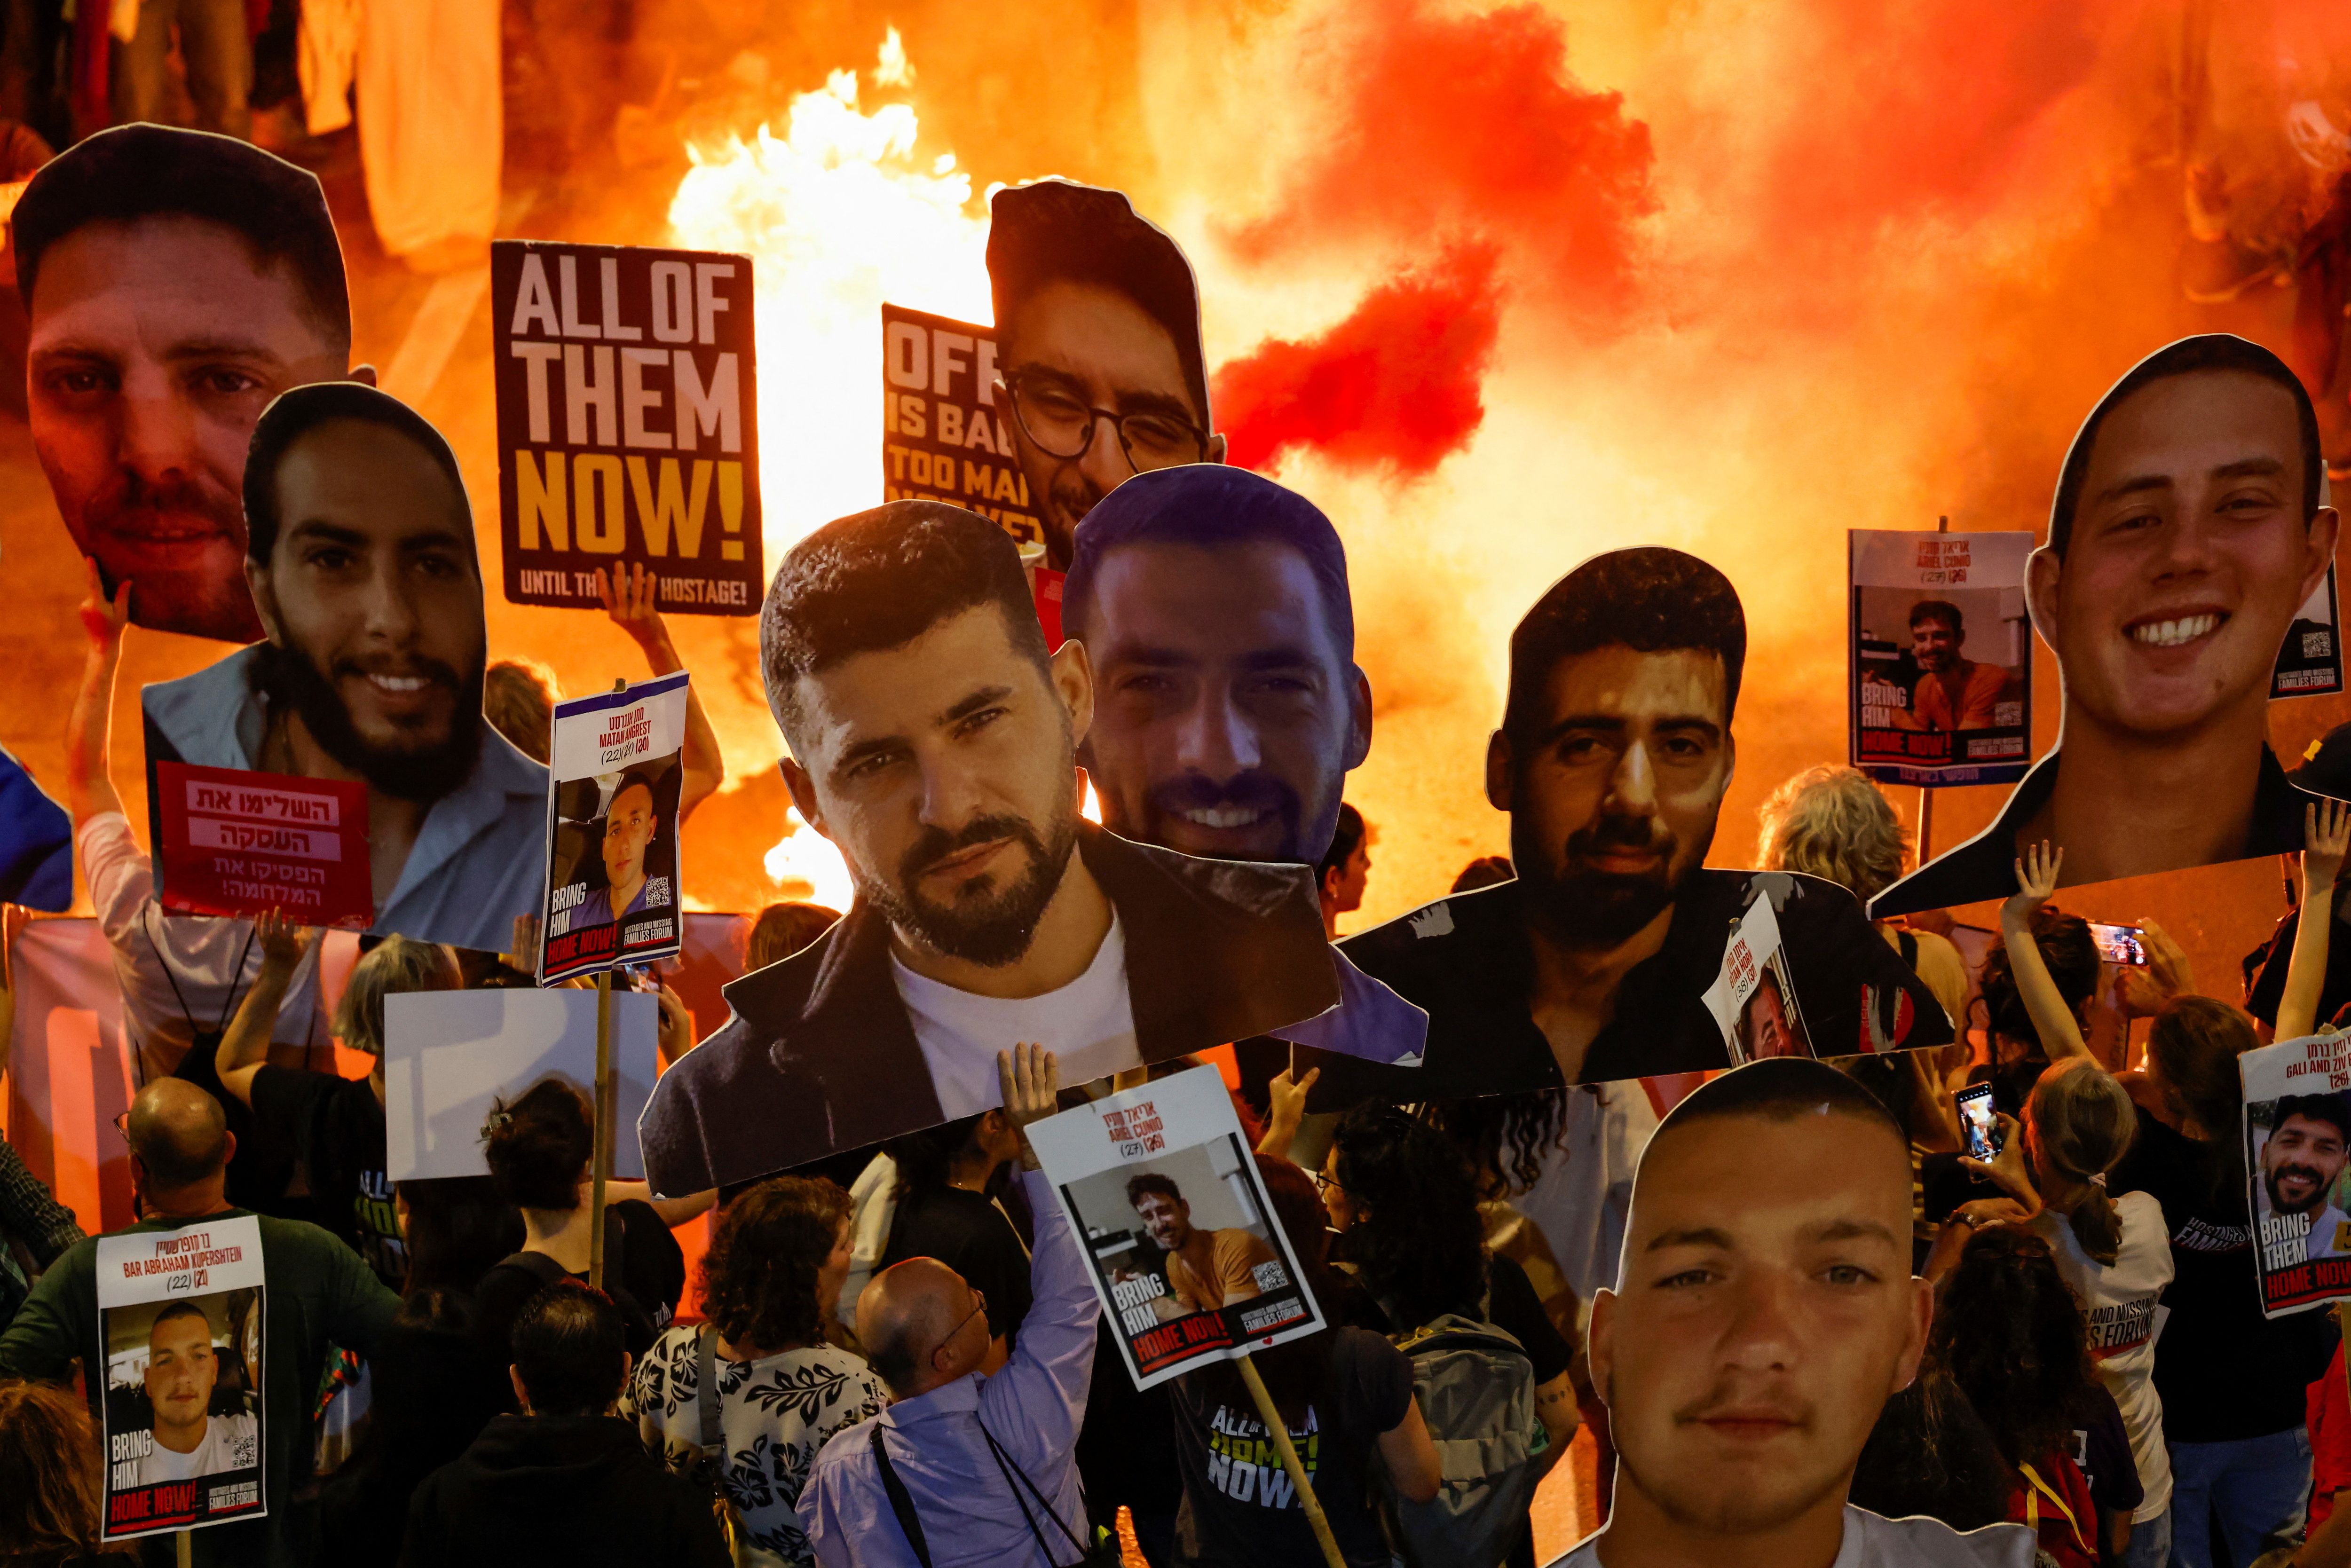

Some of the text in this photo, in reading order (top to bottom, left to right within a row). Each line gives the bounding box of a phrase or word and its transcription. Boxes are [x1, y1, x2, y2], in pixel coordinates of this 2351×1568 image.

[511, 253, 735, 345] ALL OF
[511, 340, 742, 453] THEM
[887, 392, 926, 438] IS
[888, 444, 955, 490] TOO
[515, 449, 744, 560] NOW!
[521, 570, 572, 597] UNTIL
[574, 572, 604, 599] TH
[660, 578, 748, 606] HOSTAGE!
[1862, 682, 1907, 707] BRING
[634, 707, 644, 724] מתן
[1862, 706, 1890, 727] HIM
[600, 720, 651, 748] MATAN ANGREST
[1862, 730, 1904, 752] HOME
[1908, 732, 1951, 756] NOW!
[601, 748, 622, 766] (22)
[636, 735, 649, 754] (20)
[197, 788, 329, 821] השלימו את
[220, 825, 310, 853] העסקה
[214, 857, 325, 885] הפסיקו את
[223, 880, 321, 906] המלחמה!
[552, 882, 586, 914] BRING
[550, 910, 571, 938] HIM
[624, 926, 673, 946] FAMILIES FORUM
[625, 918, 672, 934] HOSTAGES AND MISSING
[547, 923, 617, 965] HOME NOW!
[1735, 977, 1748, 1003] (38)
[2287, 1061, 2307, 1079] GALI
[2310, 1059, 2330, 1073] AND
[2333, 1055, 2346, 1072] ZIV
[1121, 1142, 1144, 1158] (27)
[2260, 1212, 2311, 1245] BRING
[123, 1261, 142, 1278] BAR
[144, 1255, 189, 1276] ABRAHAM
[2264, 1238, 2308, 1271] THEM
[167, 1274, 192, 1293] (22)
[1111, 1272, 1165, 1312] BRING
[2267, 1266, 2313, 1299] HOME
[1121, 1303, 1159, 1337] HIM
[2089, 1307, 2114, 1324] AND
[1133, 1312, 1228, 1363] HOME NOW!
[1211, 1405, 1250, 1437] ALL
[111, 1428, 152, 1462] BRING
[112, 1461, 139, 1491] HIM
[1208, 1449, 1315, 1509] NOW
[110, 1490, 151, 1522] HOME
[154, 1480, 196, 1515] NOW!
